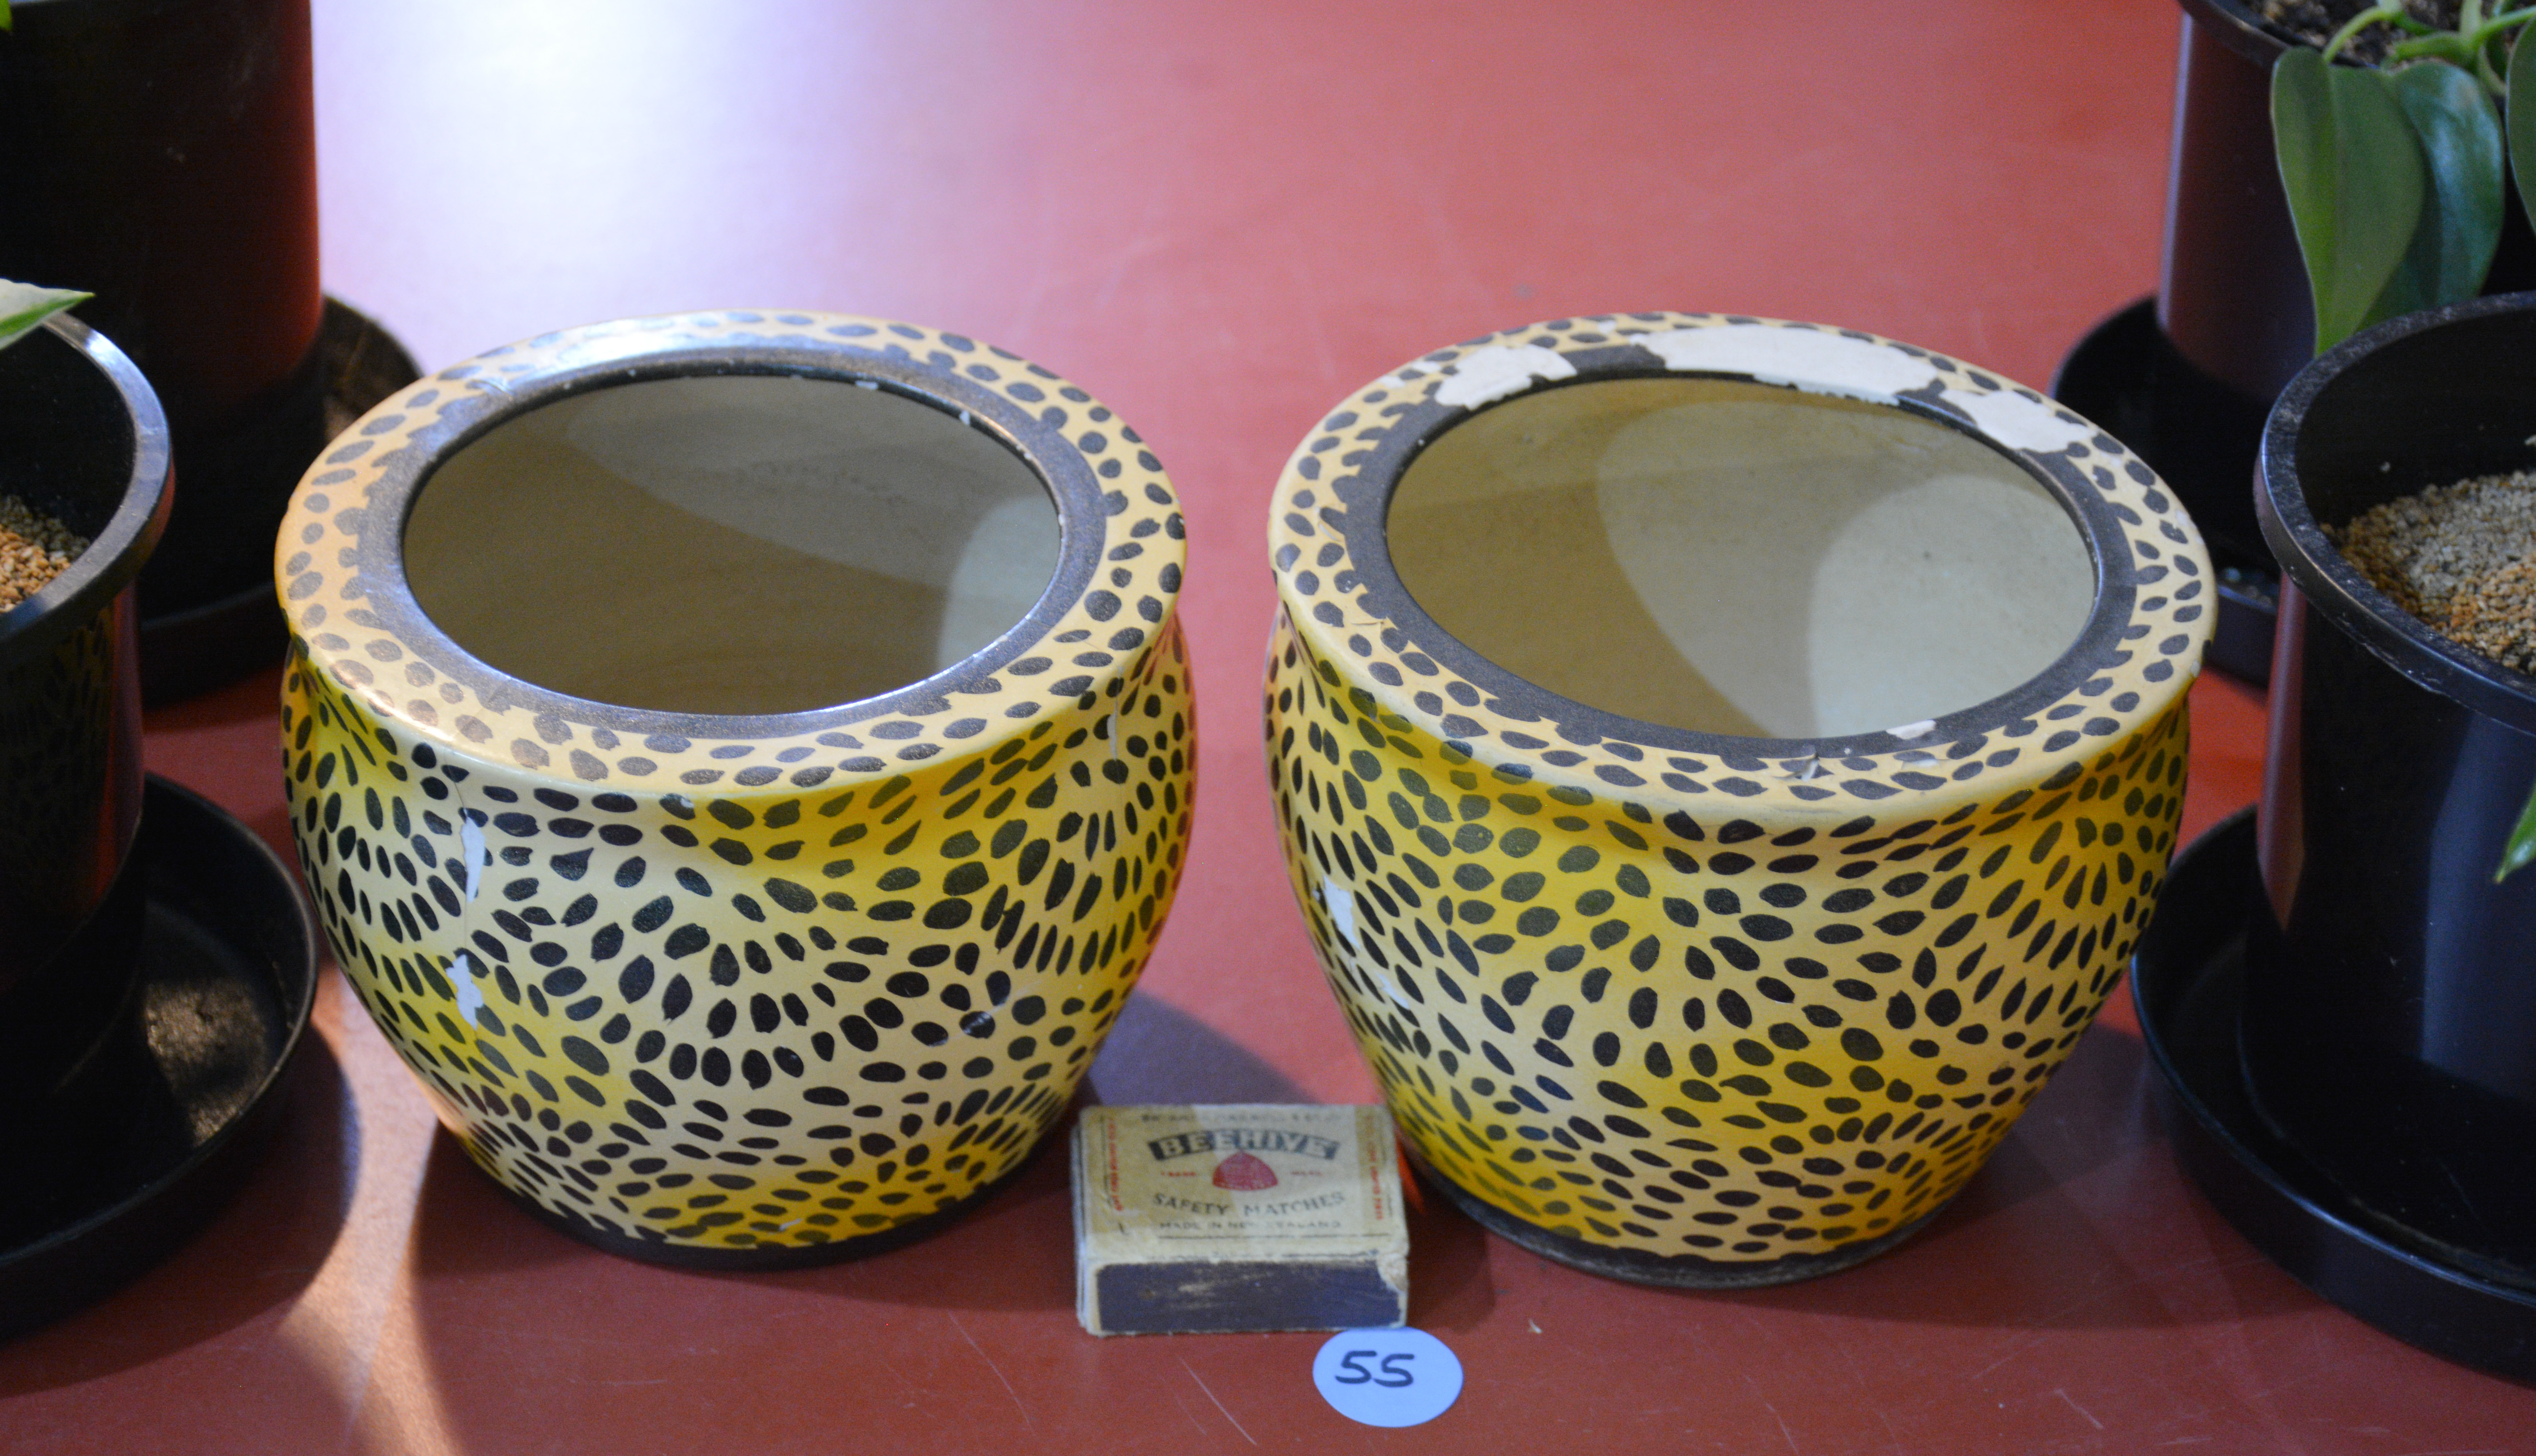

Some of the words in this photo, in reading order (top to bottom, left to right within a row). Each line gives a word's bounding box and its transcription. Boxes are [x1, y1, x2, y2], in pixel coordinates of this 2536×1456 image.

[1158, 1130, 1333, 1160] BEEHIVE
[1154, 1193, 1230, 1216] SAFETY
[1243, 1191, 1346, 1217] MATCHES
